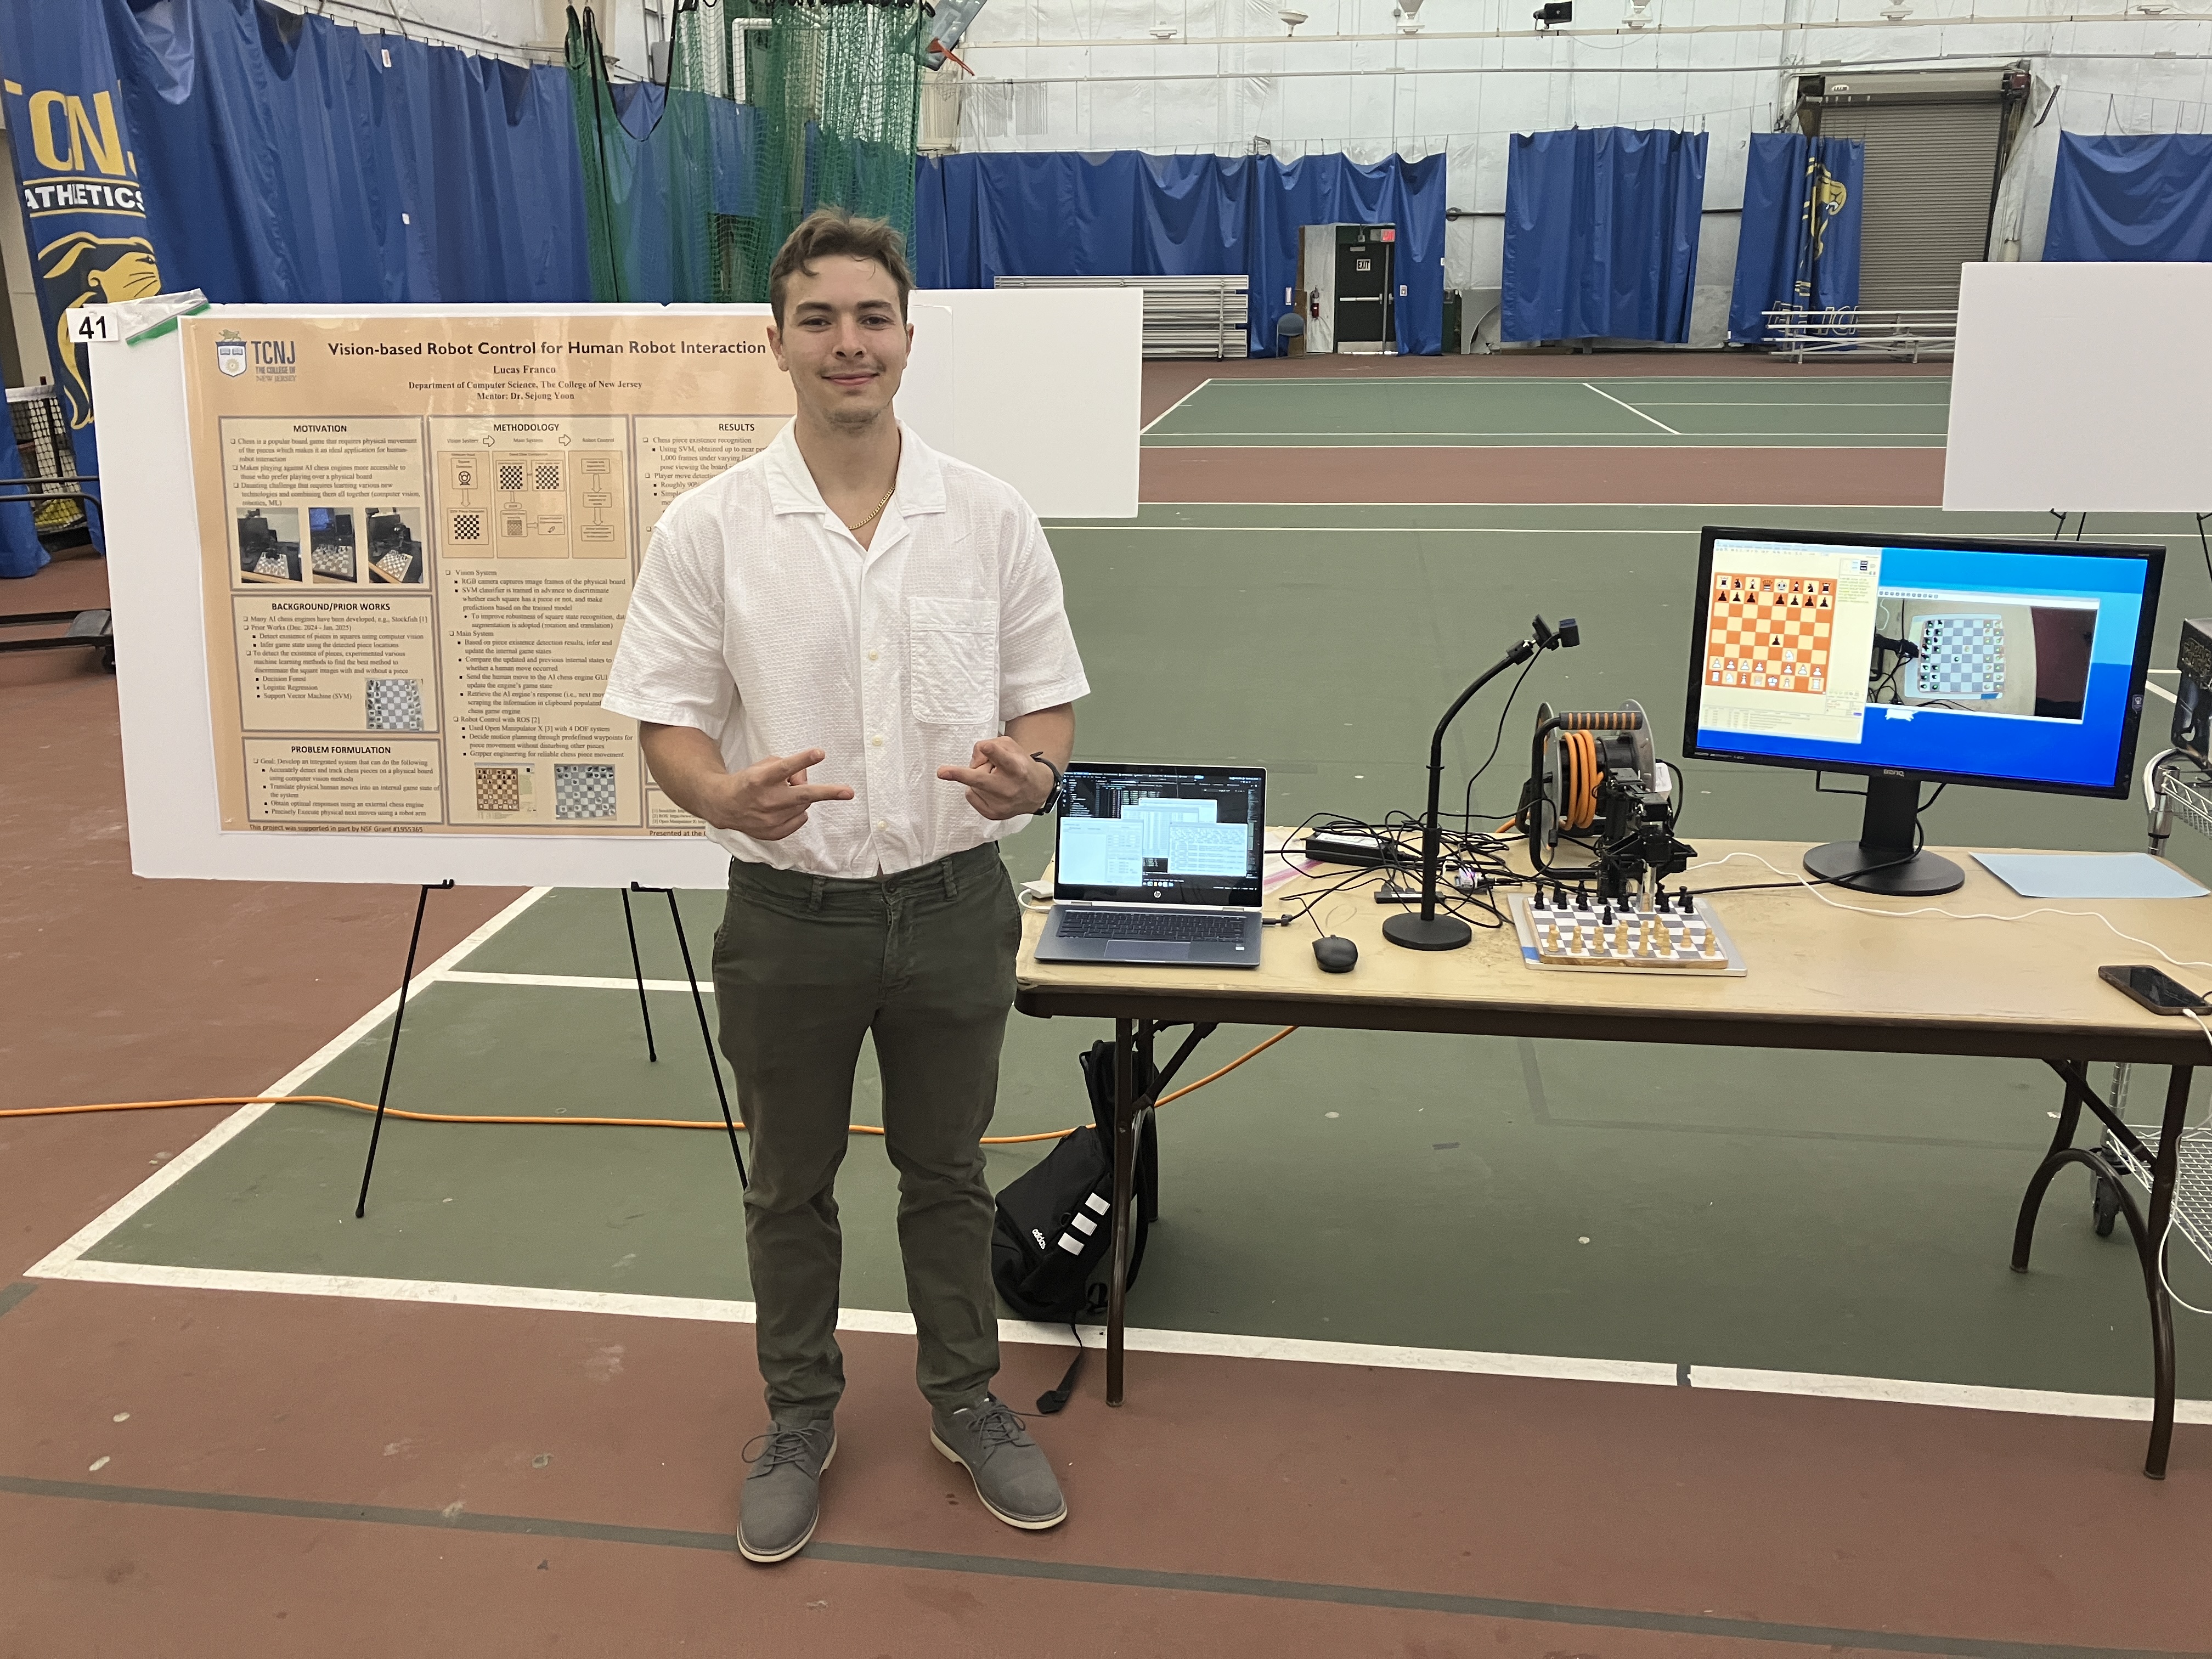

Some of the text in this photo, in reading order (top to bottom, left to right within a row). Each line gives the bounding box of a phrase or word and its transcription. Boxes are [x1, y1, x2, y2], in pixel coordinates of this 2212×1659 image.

[1358, 261, 1369, 269] EXIT
[79, 315, 107, 340] 41
[251, 341, 295, 364] TCNJ
[328, 341, 766, 356] Vision-based Robot Control for Human Robot Interaction
[493, 365, 556, 374] Lucas Franco
[409, 381, 455, 390] Department
[467, 381, 506, 390] Computer
[507, 381, 539, 390] Science,
[558, 381, 586, 390] College
[617, 380, 642, 390] Jersey
[525, 392, 552, 402] Sejong
[661, 481, 685, 489] Roughly
[272, 603, 358, 611] BACKGROUND/PRIOR
